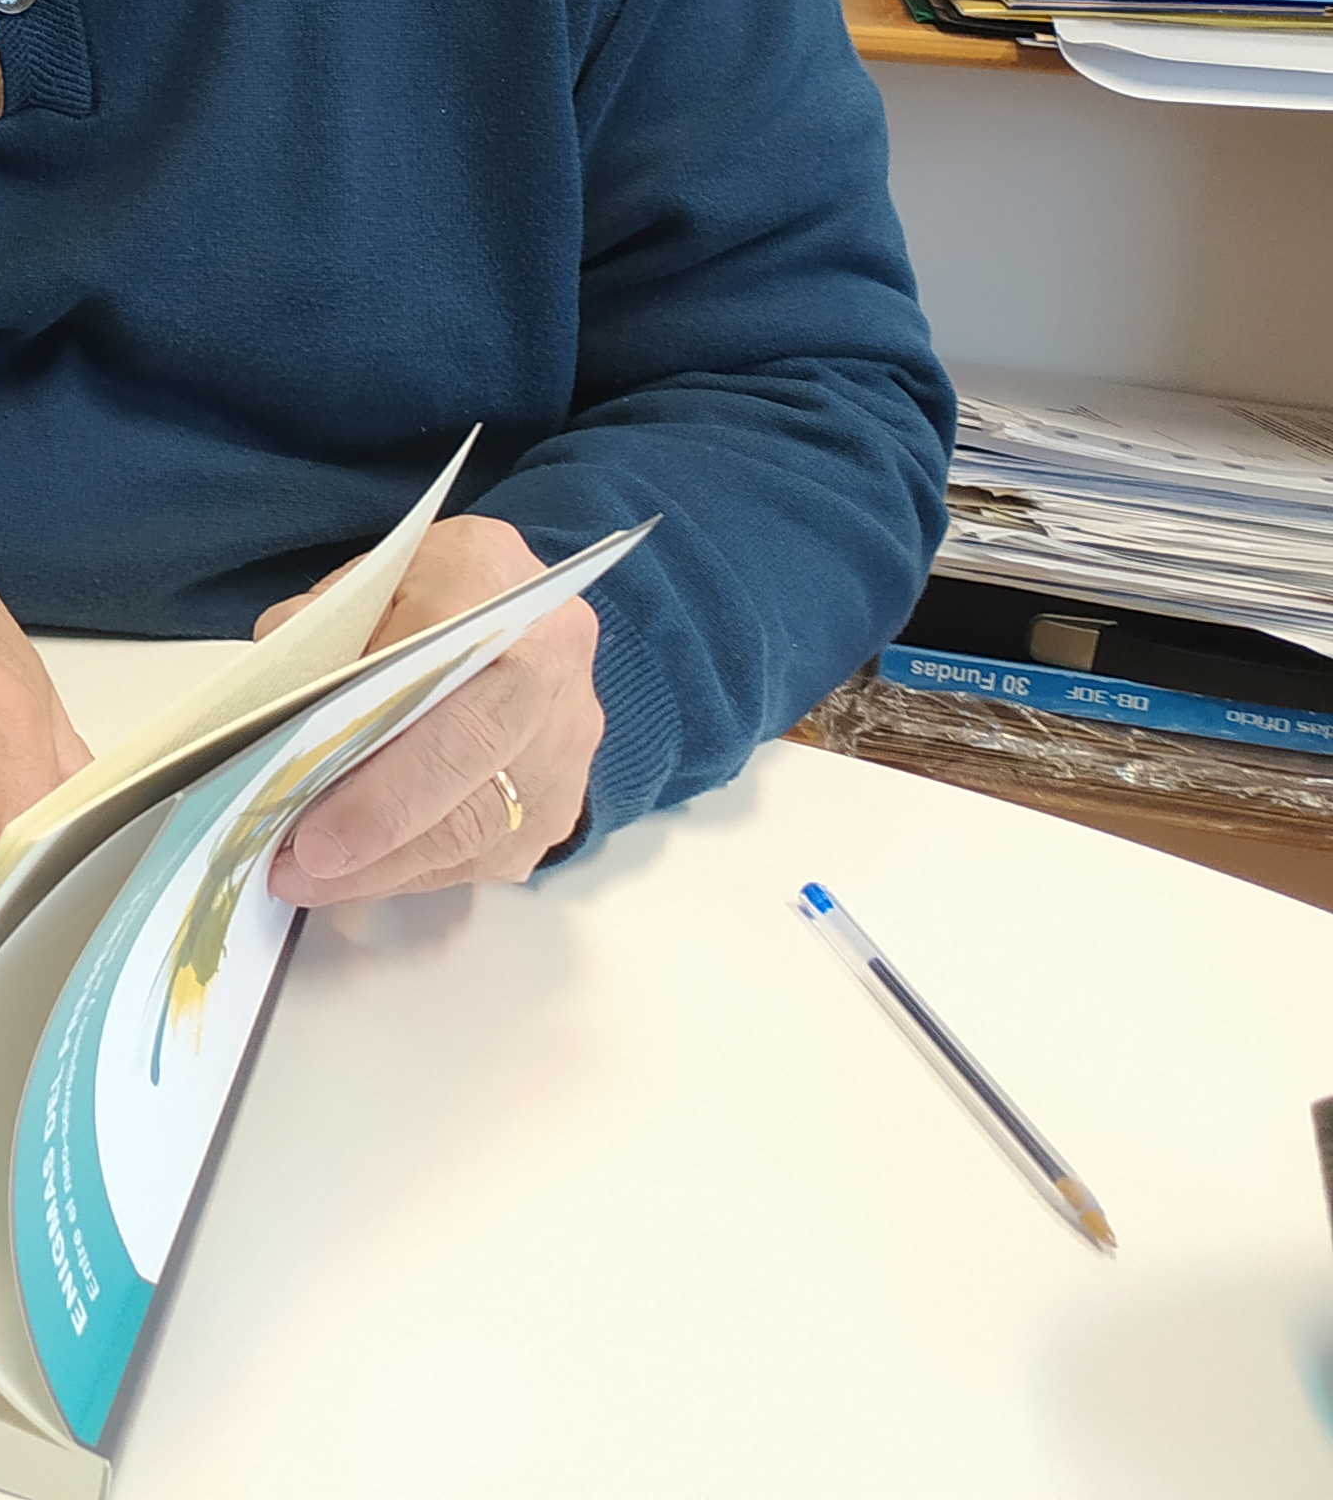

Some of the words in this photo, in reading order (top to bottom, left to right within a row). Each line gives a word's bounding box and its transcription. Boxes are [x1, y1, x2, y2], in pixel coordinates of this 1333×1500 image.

[910, 659, 997, 691] Fundas
[1002, 674, 1031, 696] 30
[1225, 710, 1291, 733] Oficio
[1296, 721, 1333, 739] das
[44, 1062, 65, 1143] DEL
[65, 1198, 76, 1223] el
[43, 1147, 88, 1336] ENIGMAS
[73, 1228, 100, 1301] Entre
